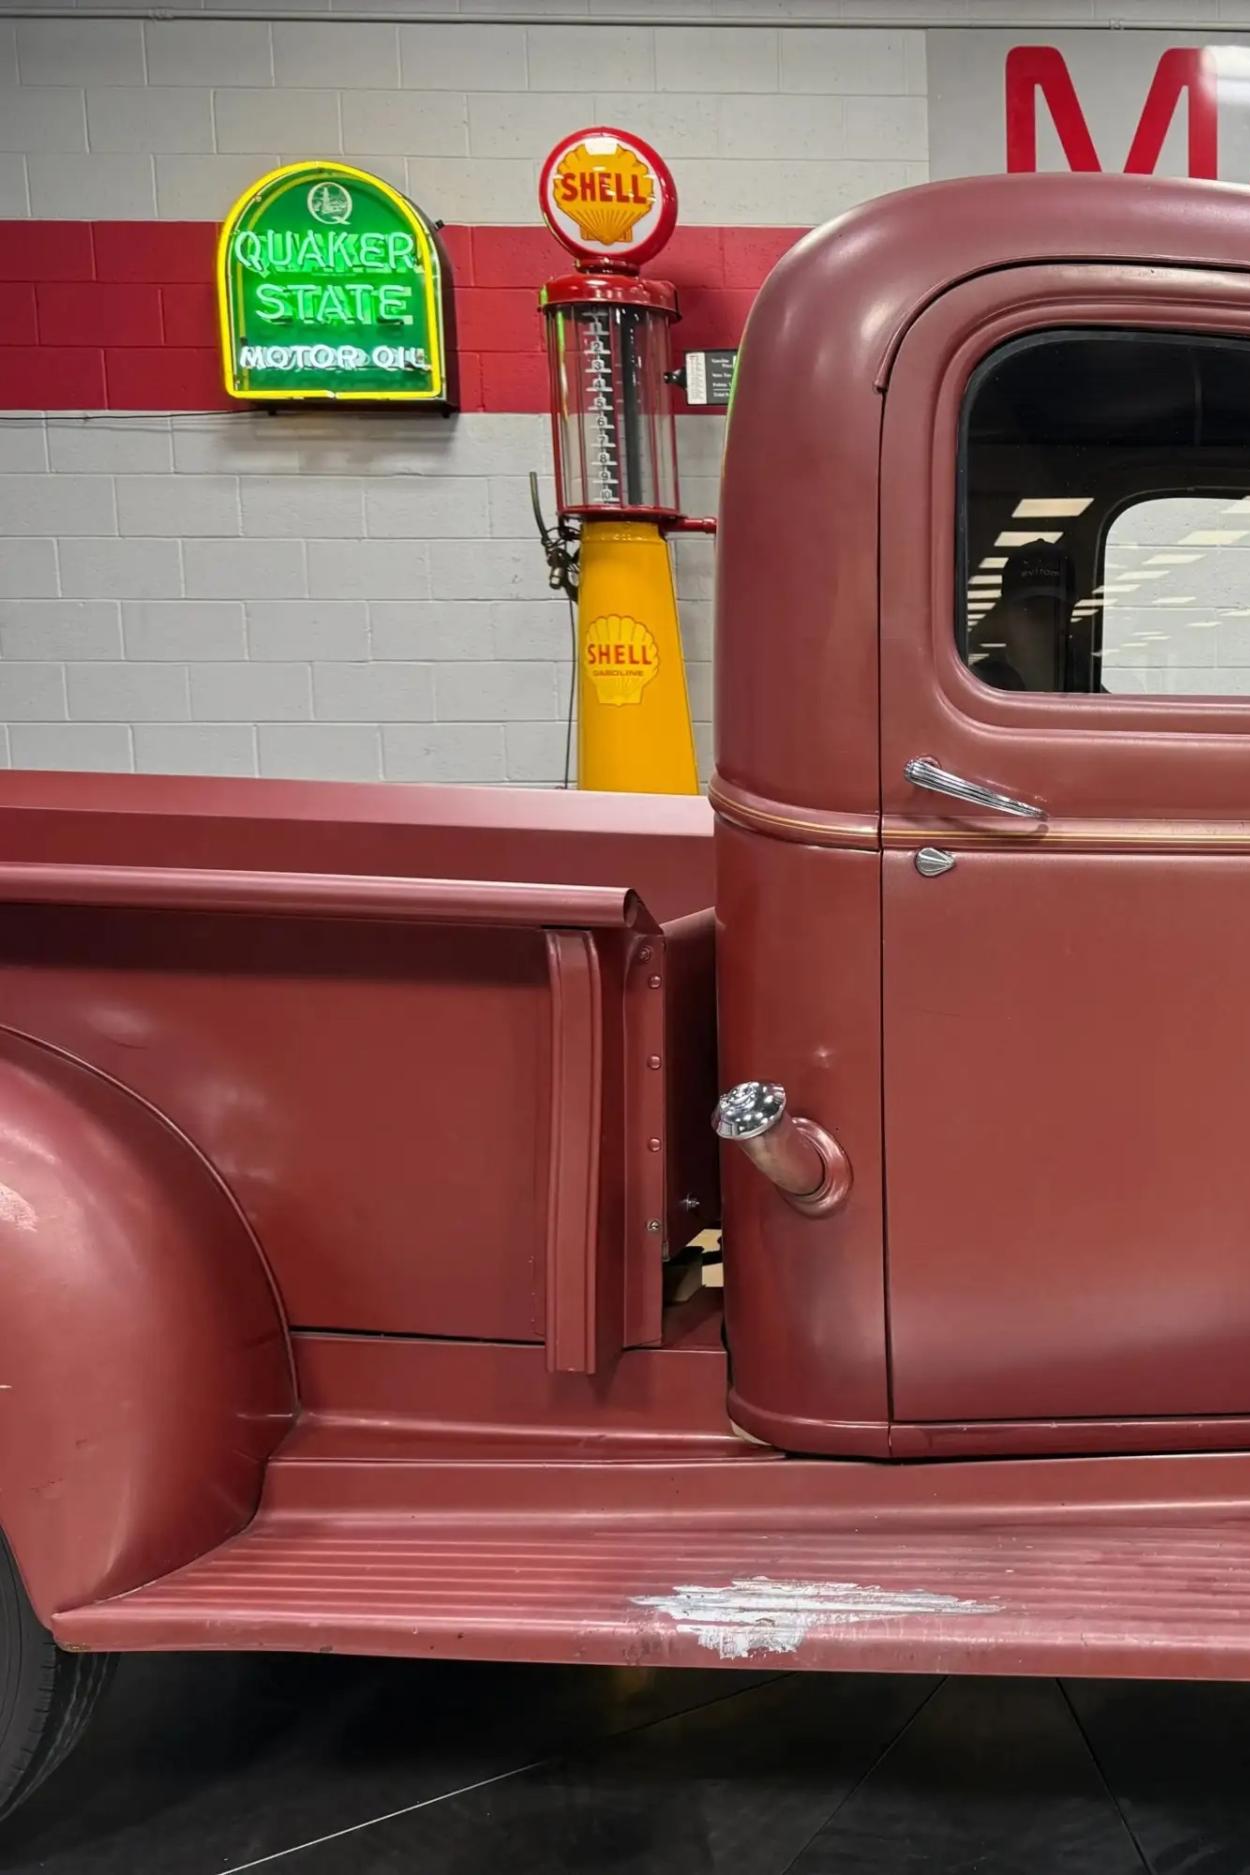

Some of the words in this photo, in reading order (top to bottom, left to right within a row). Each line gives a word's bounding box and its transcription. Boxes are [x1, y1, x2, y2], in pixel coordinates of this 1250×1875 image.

[561, 171, 648, 205] SHELL
[234, 229, 416, 273] QUAKER
[255, 283, 413, 323] STATE
[239, 344, 360, 370] MOTOR
[372, 345, 427, 369] OIL
[587, 643, 652, 665] SHELL
